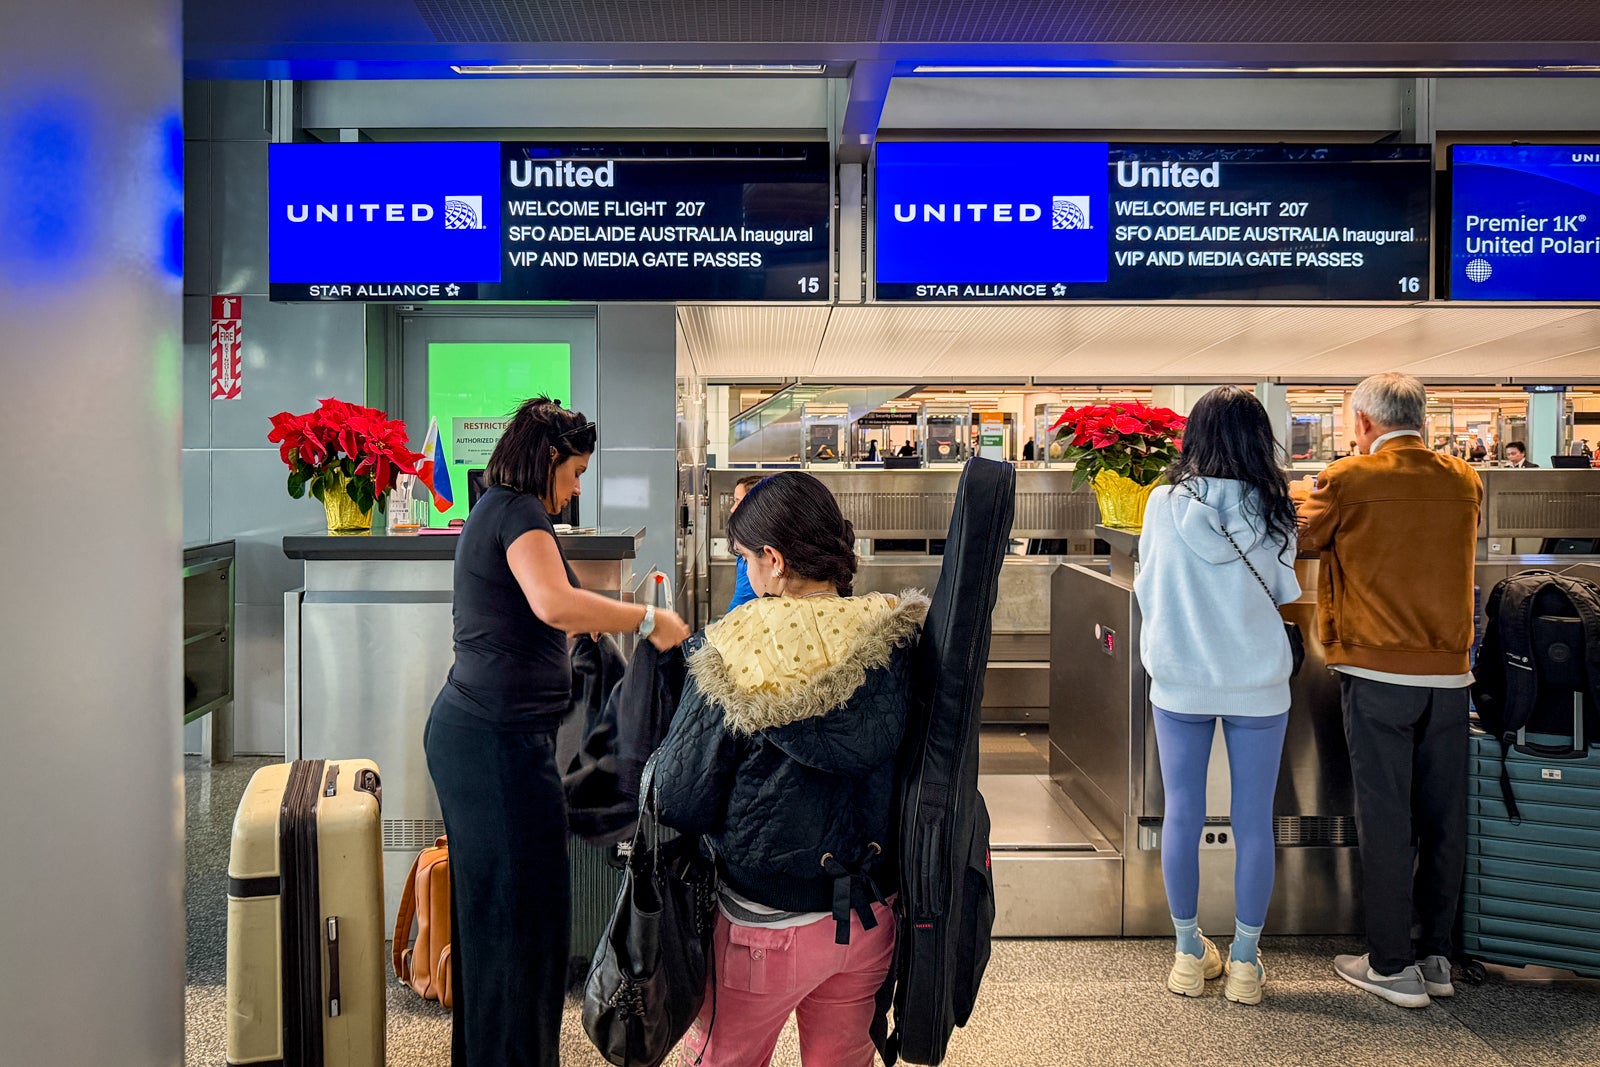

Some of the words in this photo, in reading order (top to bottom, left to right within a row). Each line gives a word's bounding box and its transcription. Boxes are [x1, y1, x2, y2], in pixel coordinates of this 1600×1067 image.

[510, 160, 614, 188] United
[1117, 161, 1220, 188] United
[287, 204, 434, 223] UNITED
[509, 201, 600, 217] WELCOME
[604, 201, 667, 217] FLIGHT
[676, 201, 706, 217] 207
[894, 203, 1042, 223] UNITED
[1115, 201, 1206, 217] WELCOME
[1209, 201, 1272, 217] FLIGHT
[1279, 202, 1309, 217] 207
[1466, 215, 1548, 232] Premier
[509, 226, 546, 242] SFO
[549, 226, 636, 242] ADELAIDE
[639, 226, 738, 242] AUSTRALIA
[741, 226, 813, 246] Inaugural
[1115, 226, 1152, 242] SFO
[1154, 226, 1241, 242] ADELAIDE
[1243, 227, 1340, 242] AUSTRALIA
[1343, 227, 1414, 246] Inaugural
[1466, 236, 1534, 254] United
[1541, 236, 1600, 254] Polari
[509, 252, 538, 267] VIP
[541, 252, 579, 267] AND
[584, 252, 640, 267] MEDIA
[643, 252, 689, 267] GATE
[693, 252, 762, 268] PASSES
[1115, 251, 1144, 266] VIP
[1147, 251, 1185, 267] AND
[1188, 251, 1244, 267] MEDIA
[1246, 252, 1293, 267] GATE
[1296, 252, 1364, 267] PASSES
[309, 284, 352, 297] STAR
[357, 284, 440, 297] ALLIANCE
[797, 277, 820, 293] 15
[915, 284, 958, 297] STAR
[963, 284, 1047, 297] ALLIANCE
[1398, 277, 1420, 293] 16
[220, 332, 234, 341] FIRE
[463, 422, 508, 430] RESTRICTE
